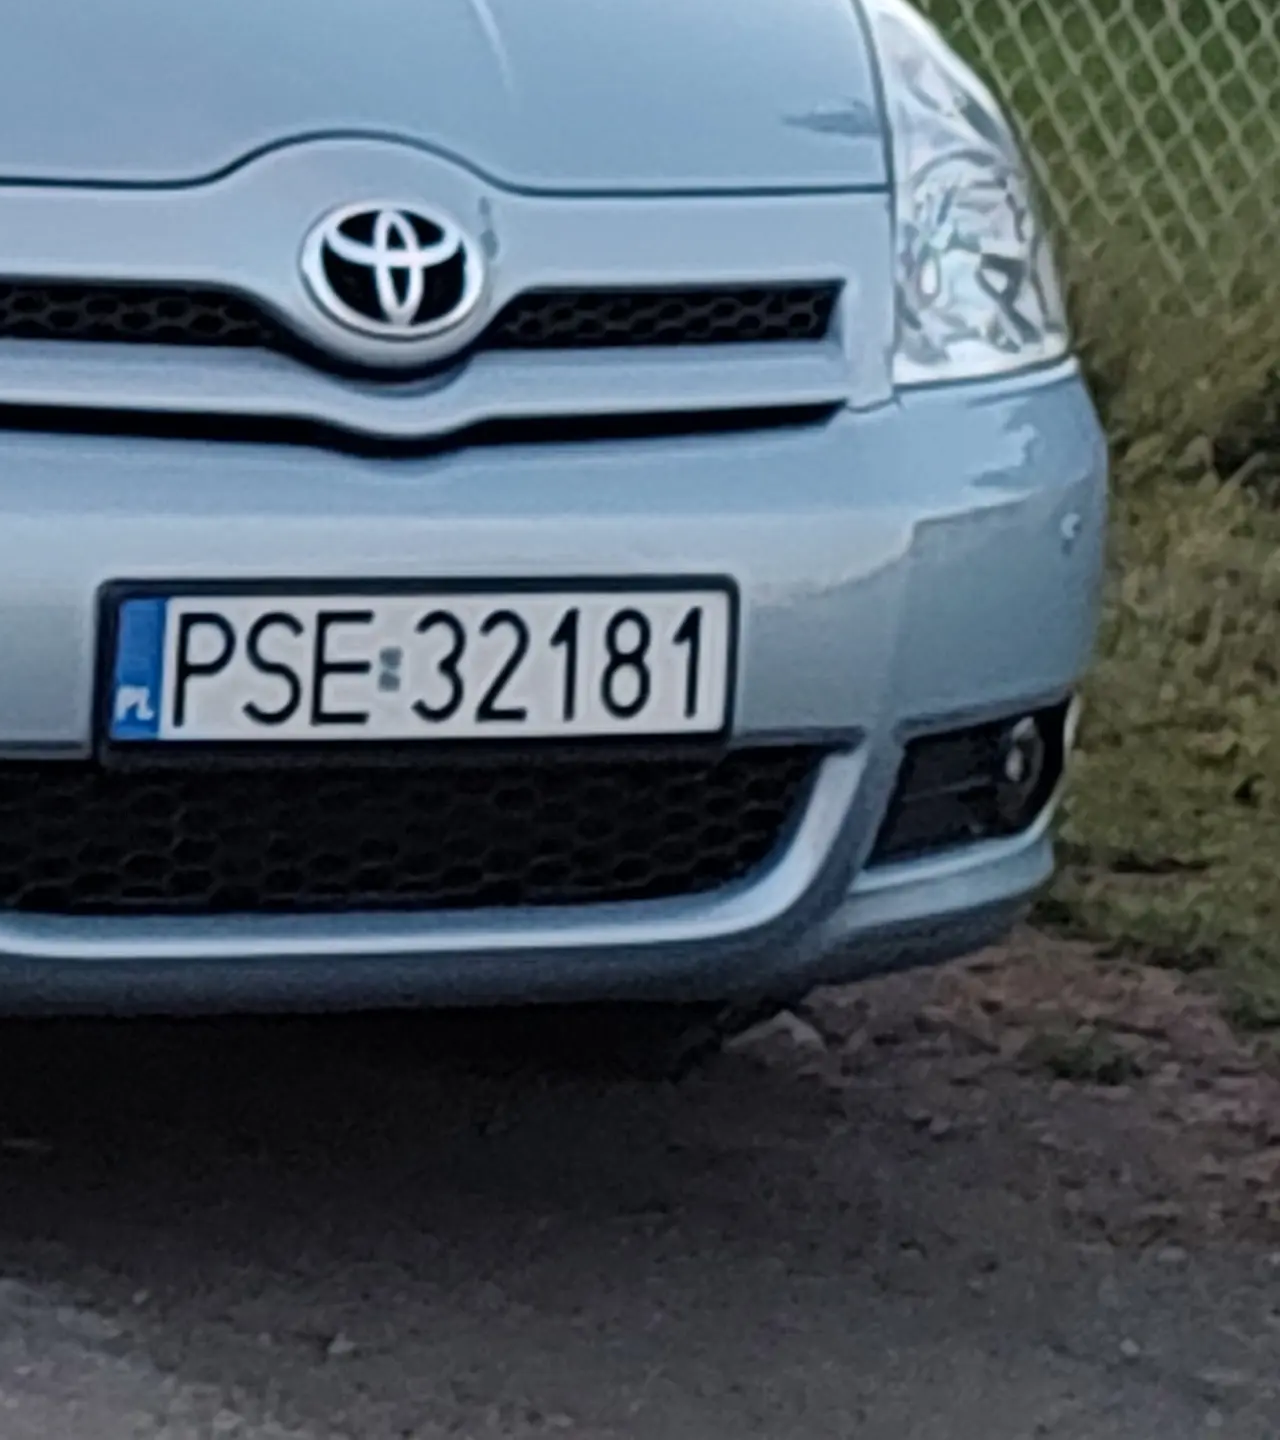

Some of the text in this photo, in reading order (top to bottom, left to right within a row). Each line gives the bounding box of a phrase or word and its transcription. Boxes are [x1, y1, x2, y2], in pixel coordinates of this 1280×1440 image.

[115, 685, 155, 722] PL
[172, 605, 704, 728] PSE 32181
